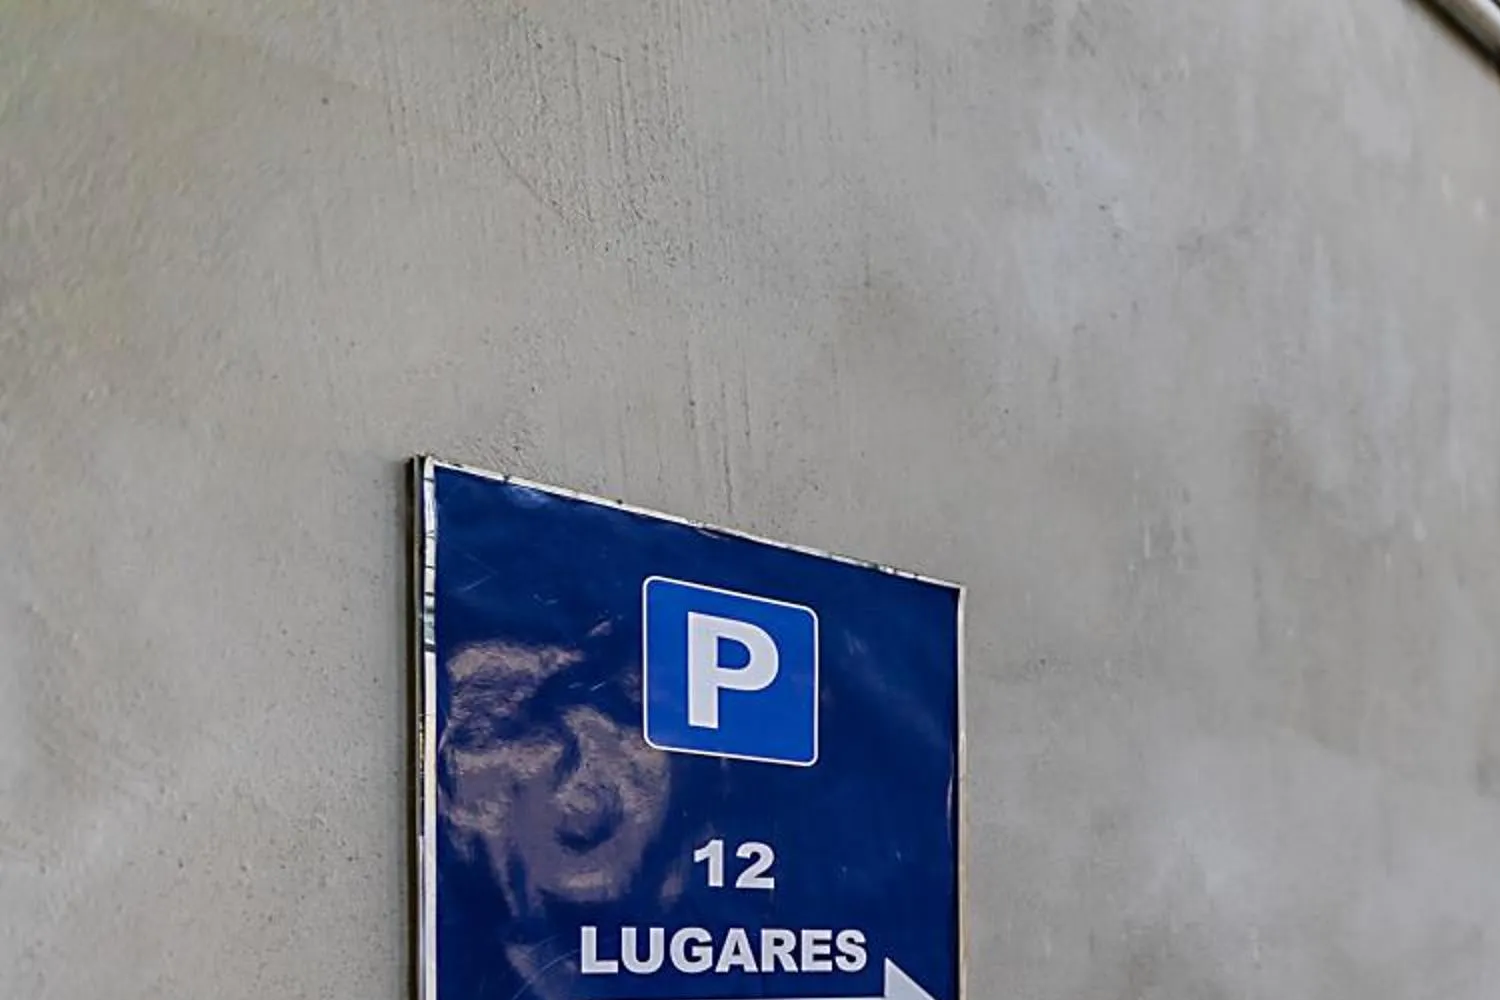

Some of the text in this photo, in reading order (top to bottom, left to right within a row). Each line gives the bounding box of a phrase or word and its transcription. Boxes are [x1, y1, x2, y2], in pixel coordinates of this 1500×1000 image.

[687, 611, 779, 729] P
[692, 839, 775, 889] 12
[580, 925, 867, 974] LUGARES
